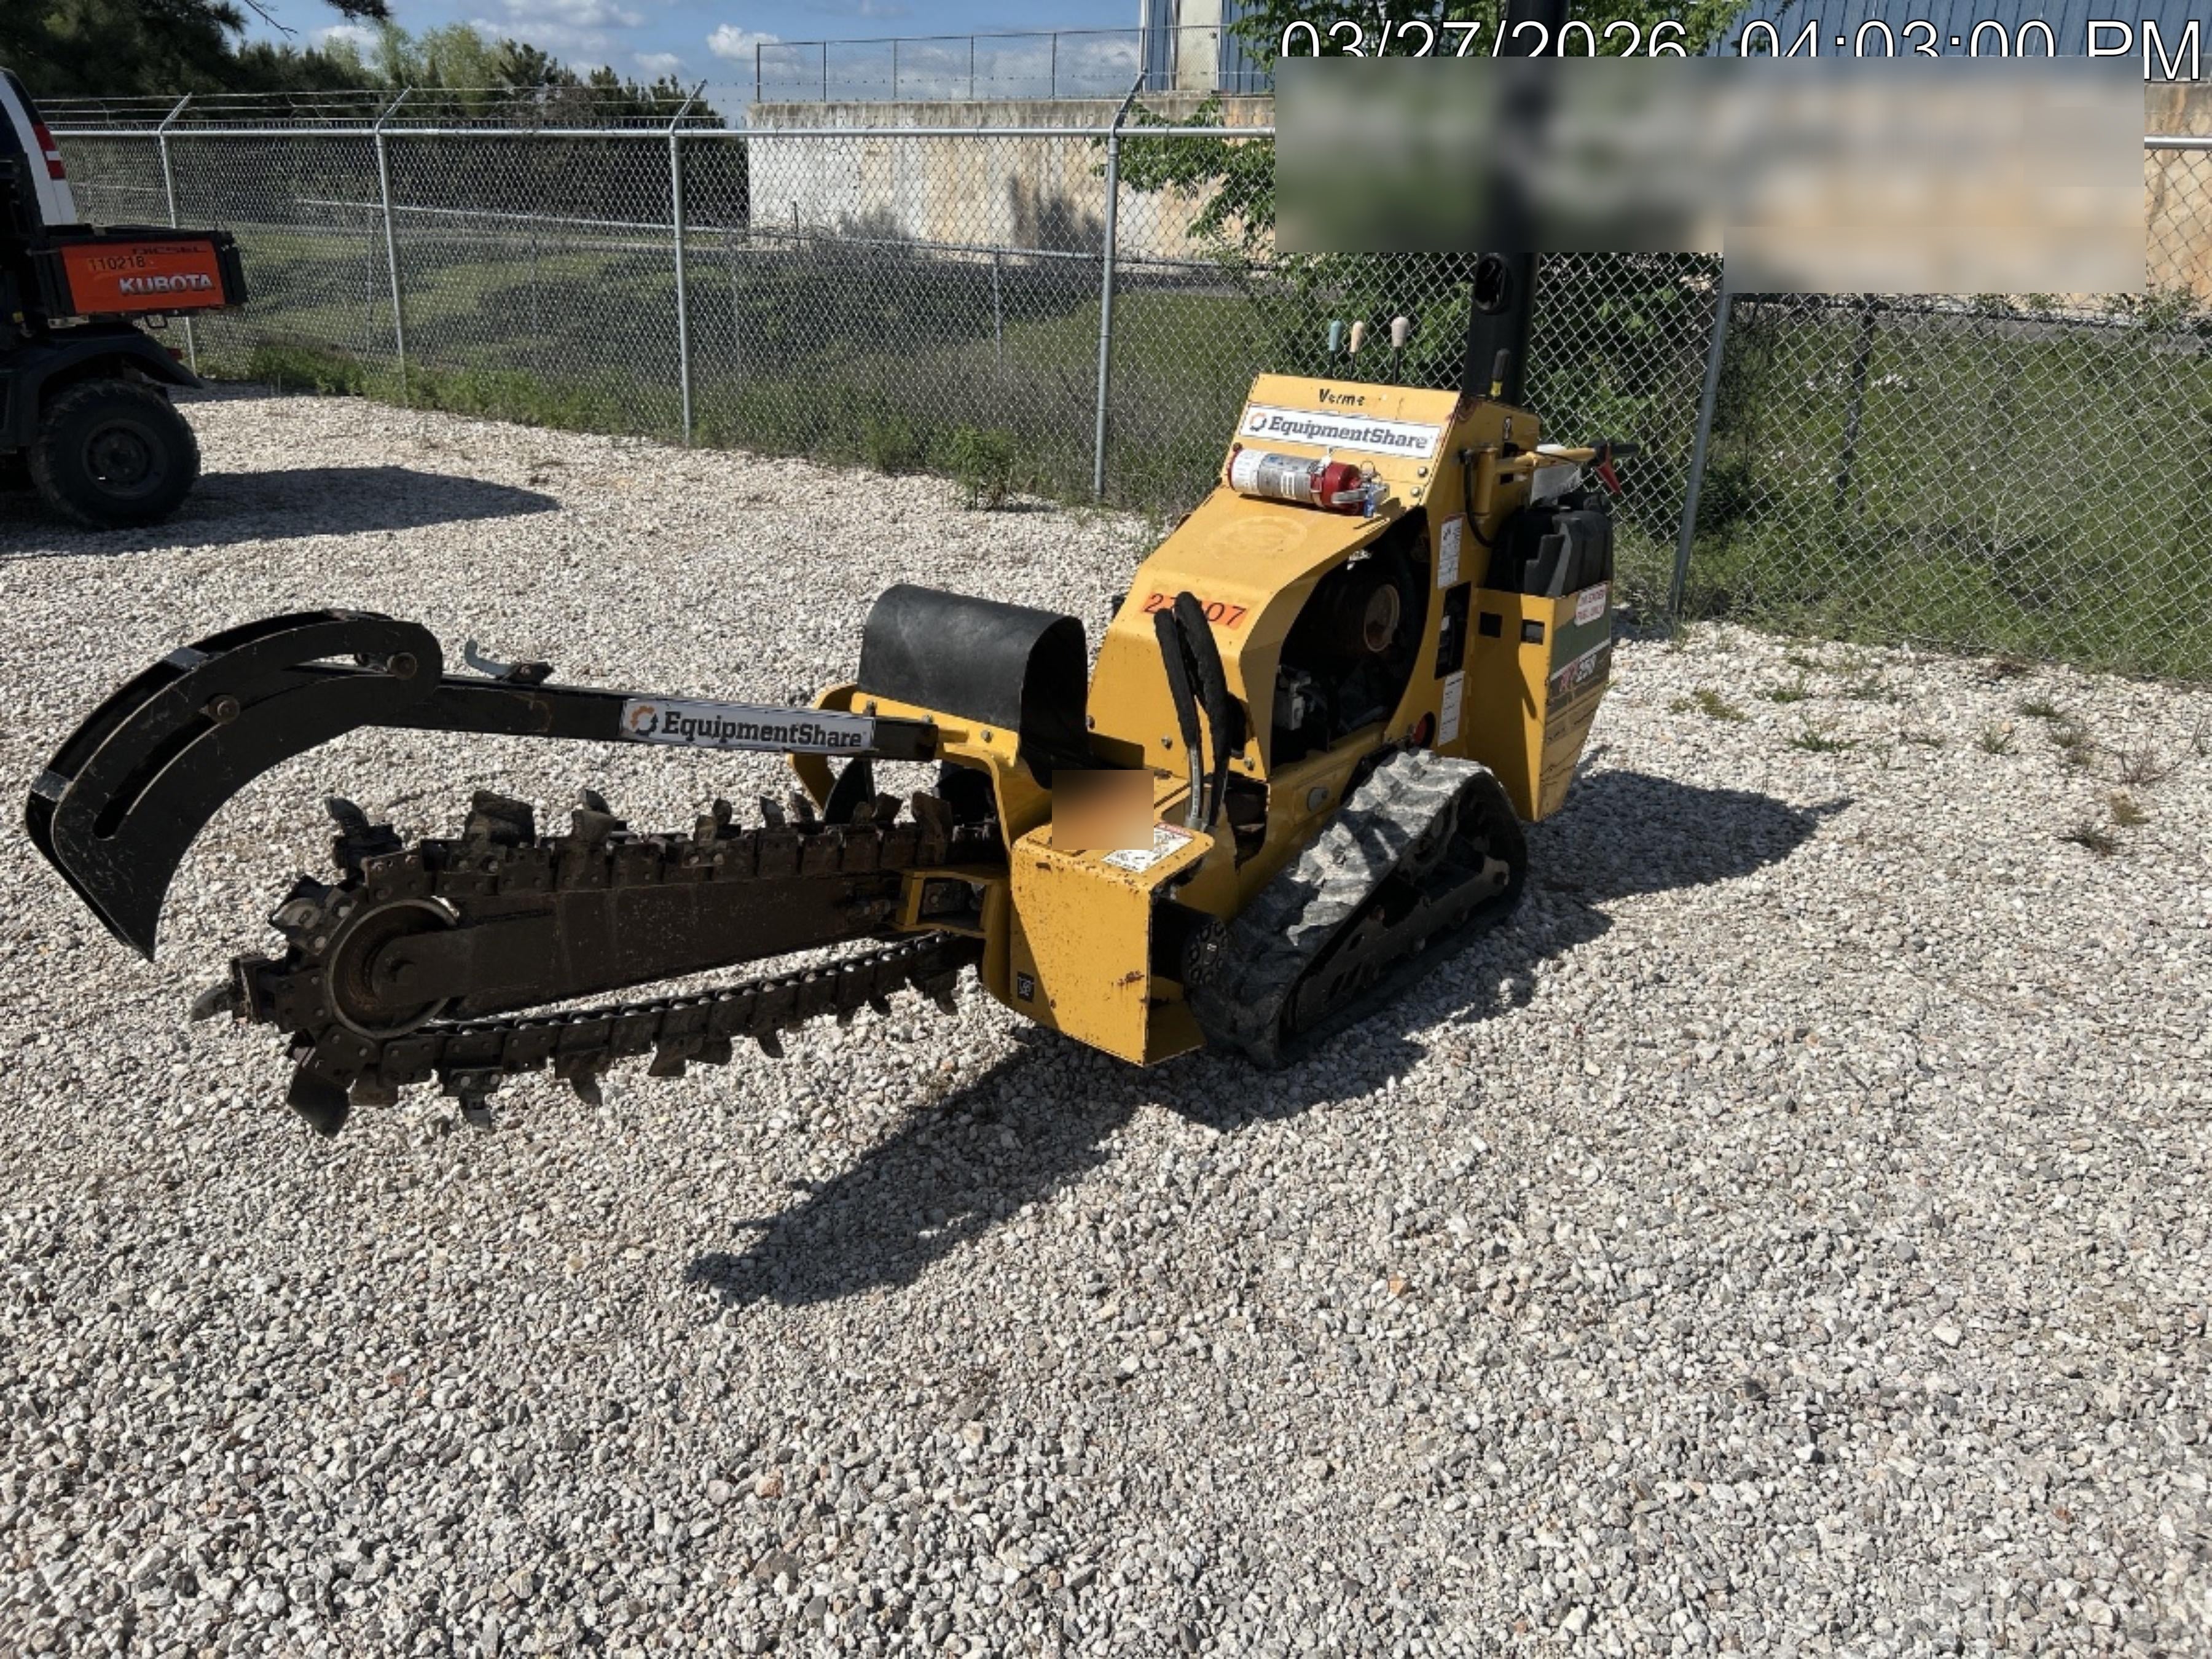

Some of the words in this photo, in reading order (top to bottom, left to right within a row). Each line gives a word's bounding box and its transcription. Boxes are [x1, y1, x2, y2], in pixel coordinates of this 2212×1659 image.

[88, 256, 146, 272] 110218
[119, 274, 213, 296] KUBOTA
[1268, 416, 1428, 449] EquipmentShare
[661, 711, 861, 748] EquipmentShare
